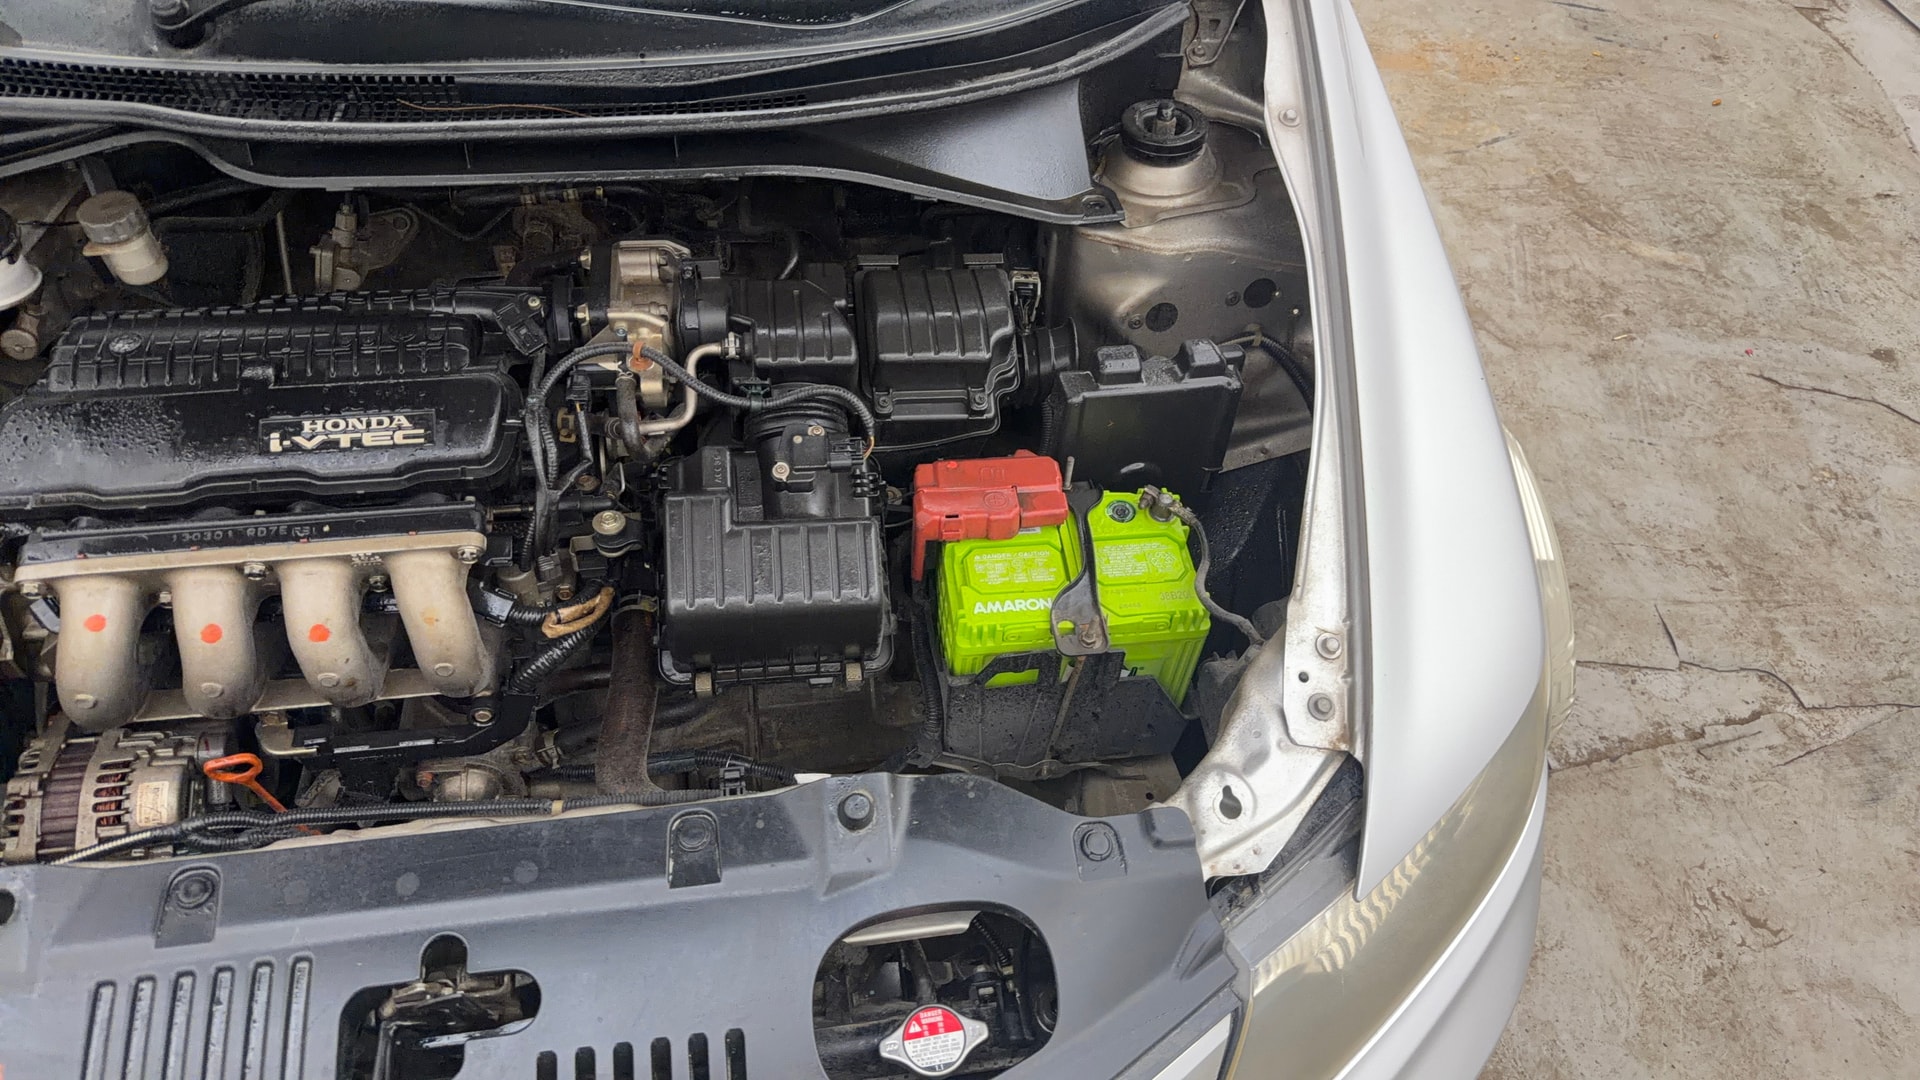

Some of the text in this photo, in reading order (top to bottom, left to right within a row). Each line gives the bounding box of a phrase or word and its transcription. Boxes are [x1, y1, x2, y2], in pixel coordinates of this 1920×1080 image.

[302, 415, 413, 433] HONDA
[270, 429, 425, 452] i-VTEC
[974, 597, 1053, 614] AMARON
